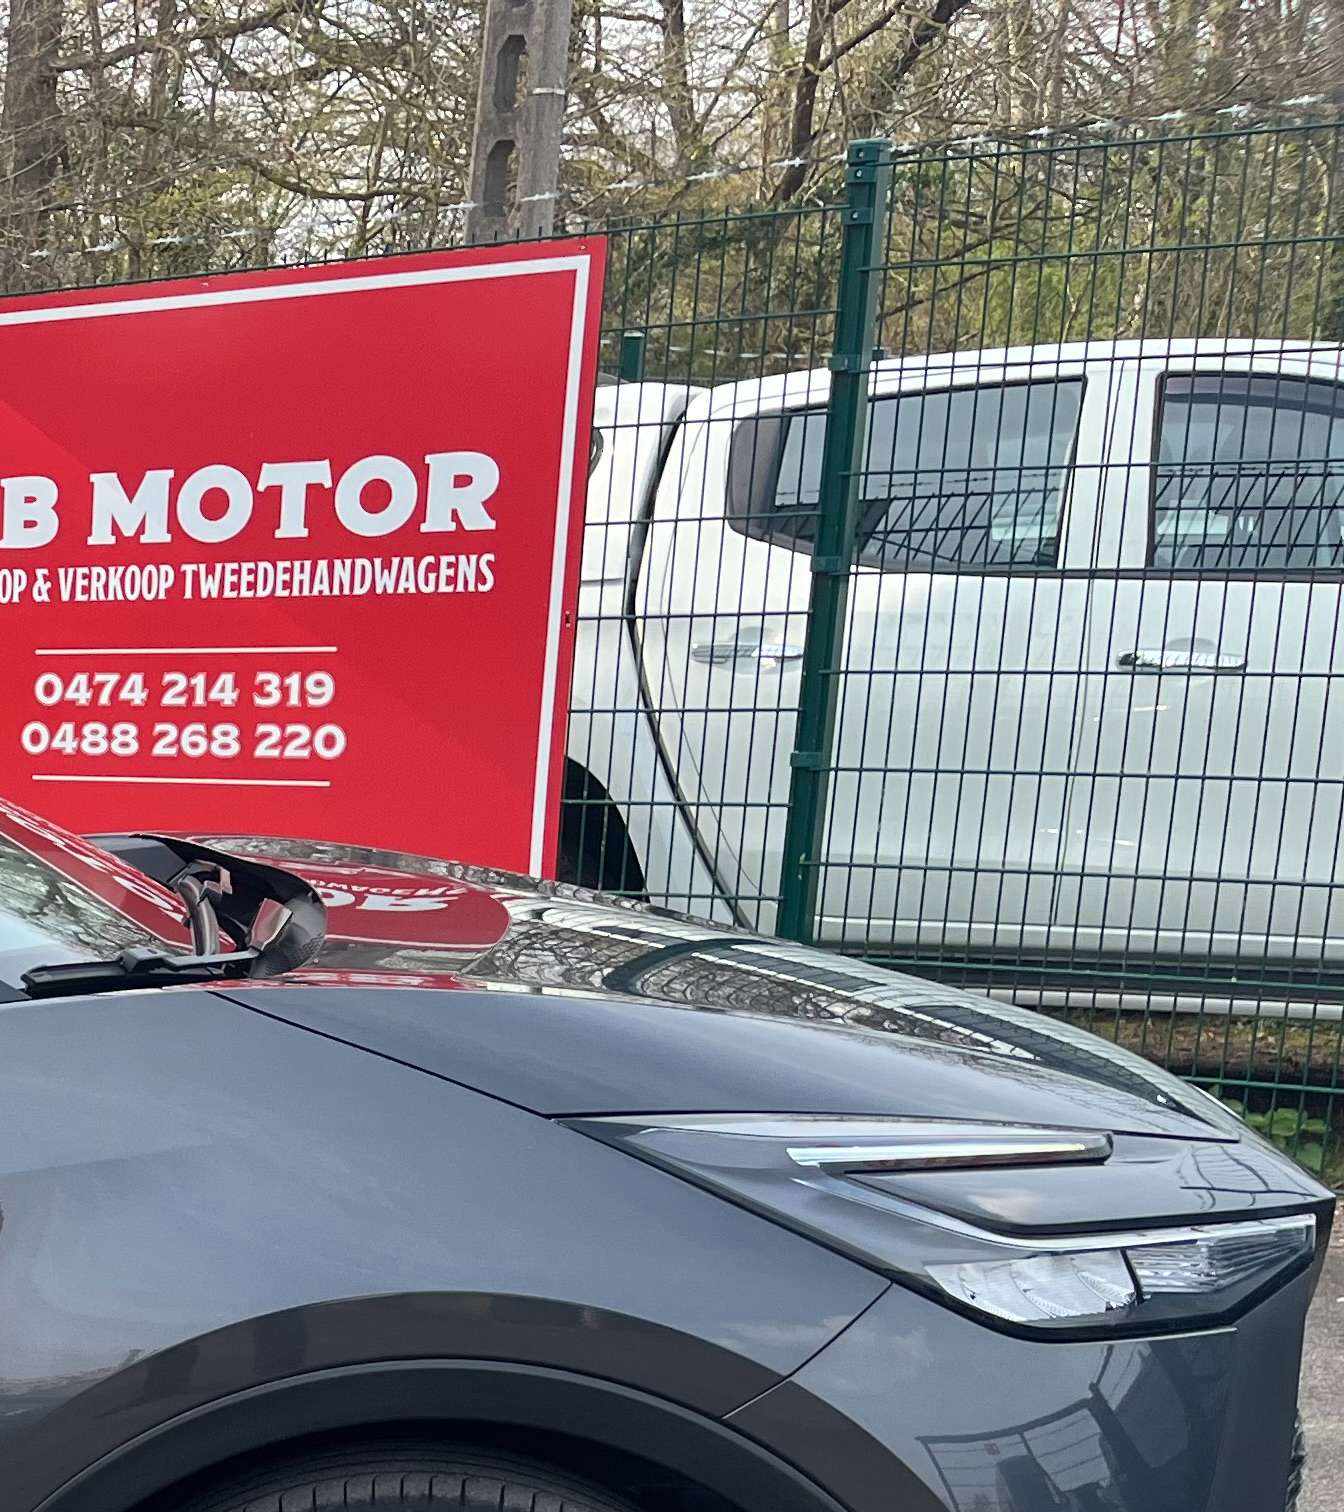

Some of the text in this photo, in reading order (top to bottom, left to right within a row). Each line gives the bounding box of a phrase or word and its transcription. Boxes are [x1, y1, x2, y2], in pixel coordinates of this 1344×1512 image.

[86, 450, 500, 546] MOTOR
[31, 568, 52, 603] &
[57, 563, 175, 602] VERKOOP
[180, 552, 496, 600] TWEEDEHANDWAGENS
[34, 670, 336, 708] 0474 214 319
[21, 720, 347, 760] 0488 268 220
